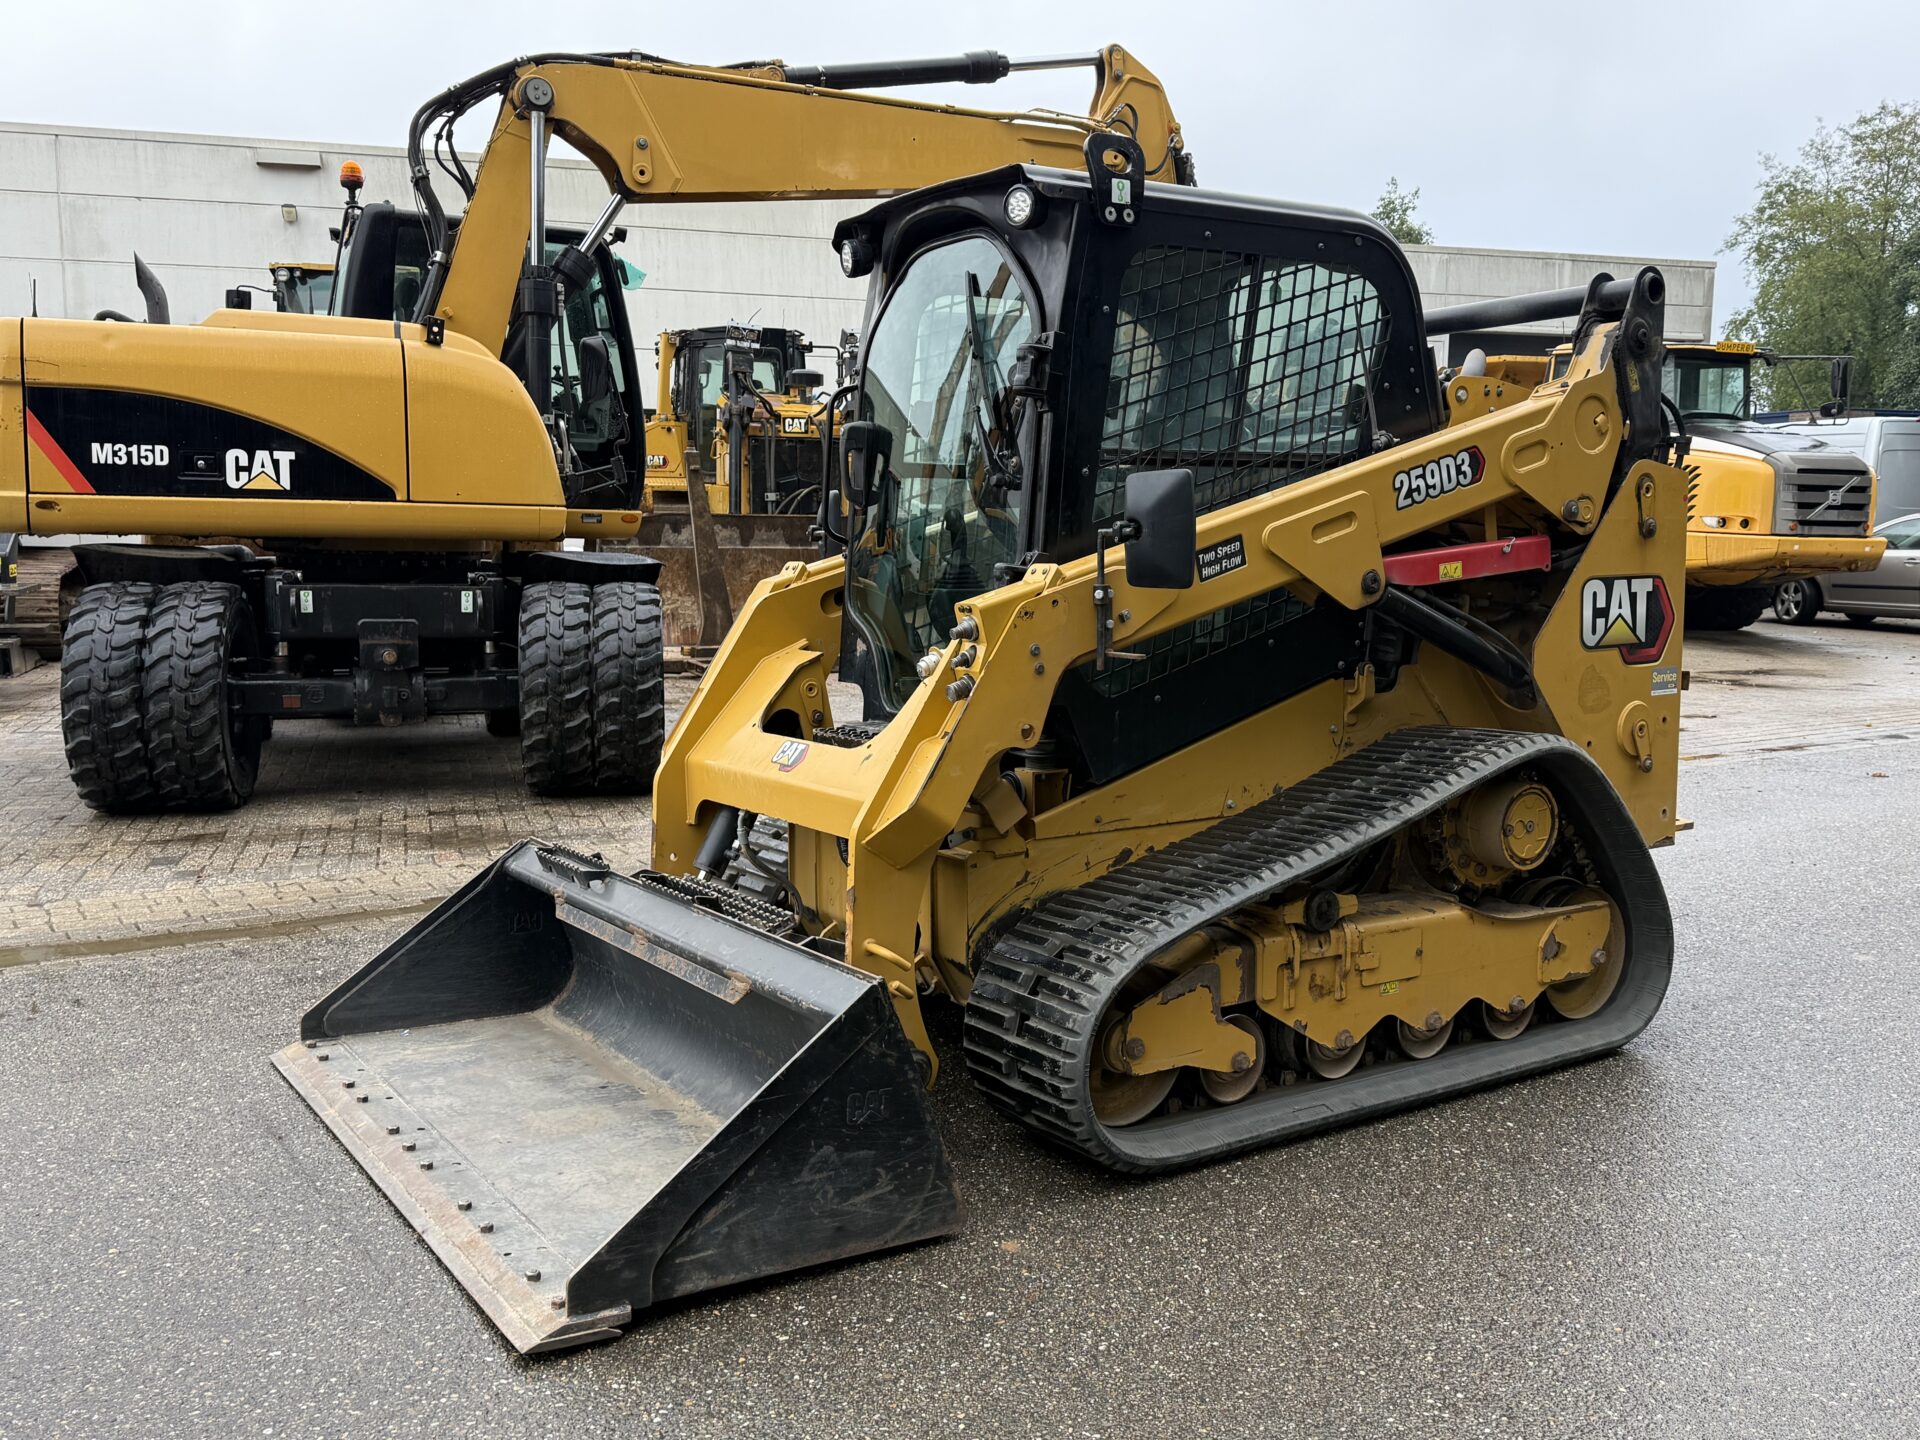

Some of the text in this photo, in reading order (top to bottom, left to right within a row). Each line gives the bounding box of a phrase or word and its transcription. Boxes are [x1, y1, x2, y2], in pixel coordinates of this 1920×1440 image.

[785, 418, 807, 433] CAT
[91, 442, 170, 466] M315D
[647, 455, 665, 466] CAT
[225, 448, 296, 491] CAT
[1394, 451, 1473, 509] 259D3
[1198, 541, 1241, 566] TWO SPEED
[1202, 555, 1242, 579] HIGH FLOW
[1582, 577, 1654, 647] CAT
[1652, 670, 1677, 683] Service
[771, 740, 807, 766] CAT
[846, 1087, 894, 1125] CAT
